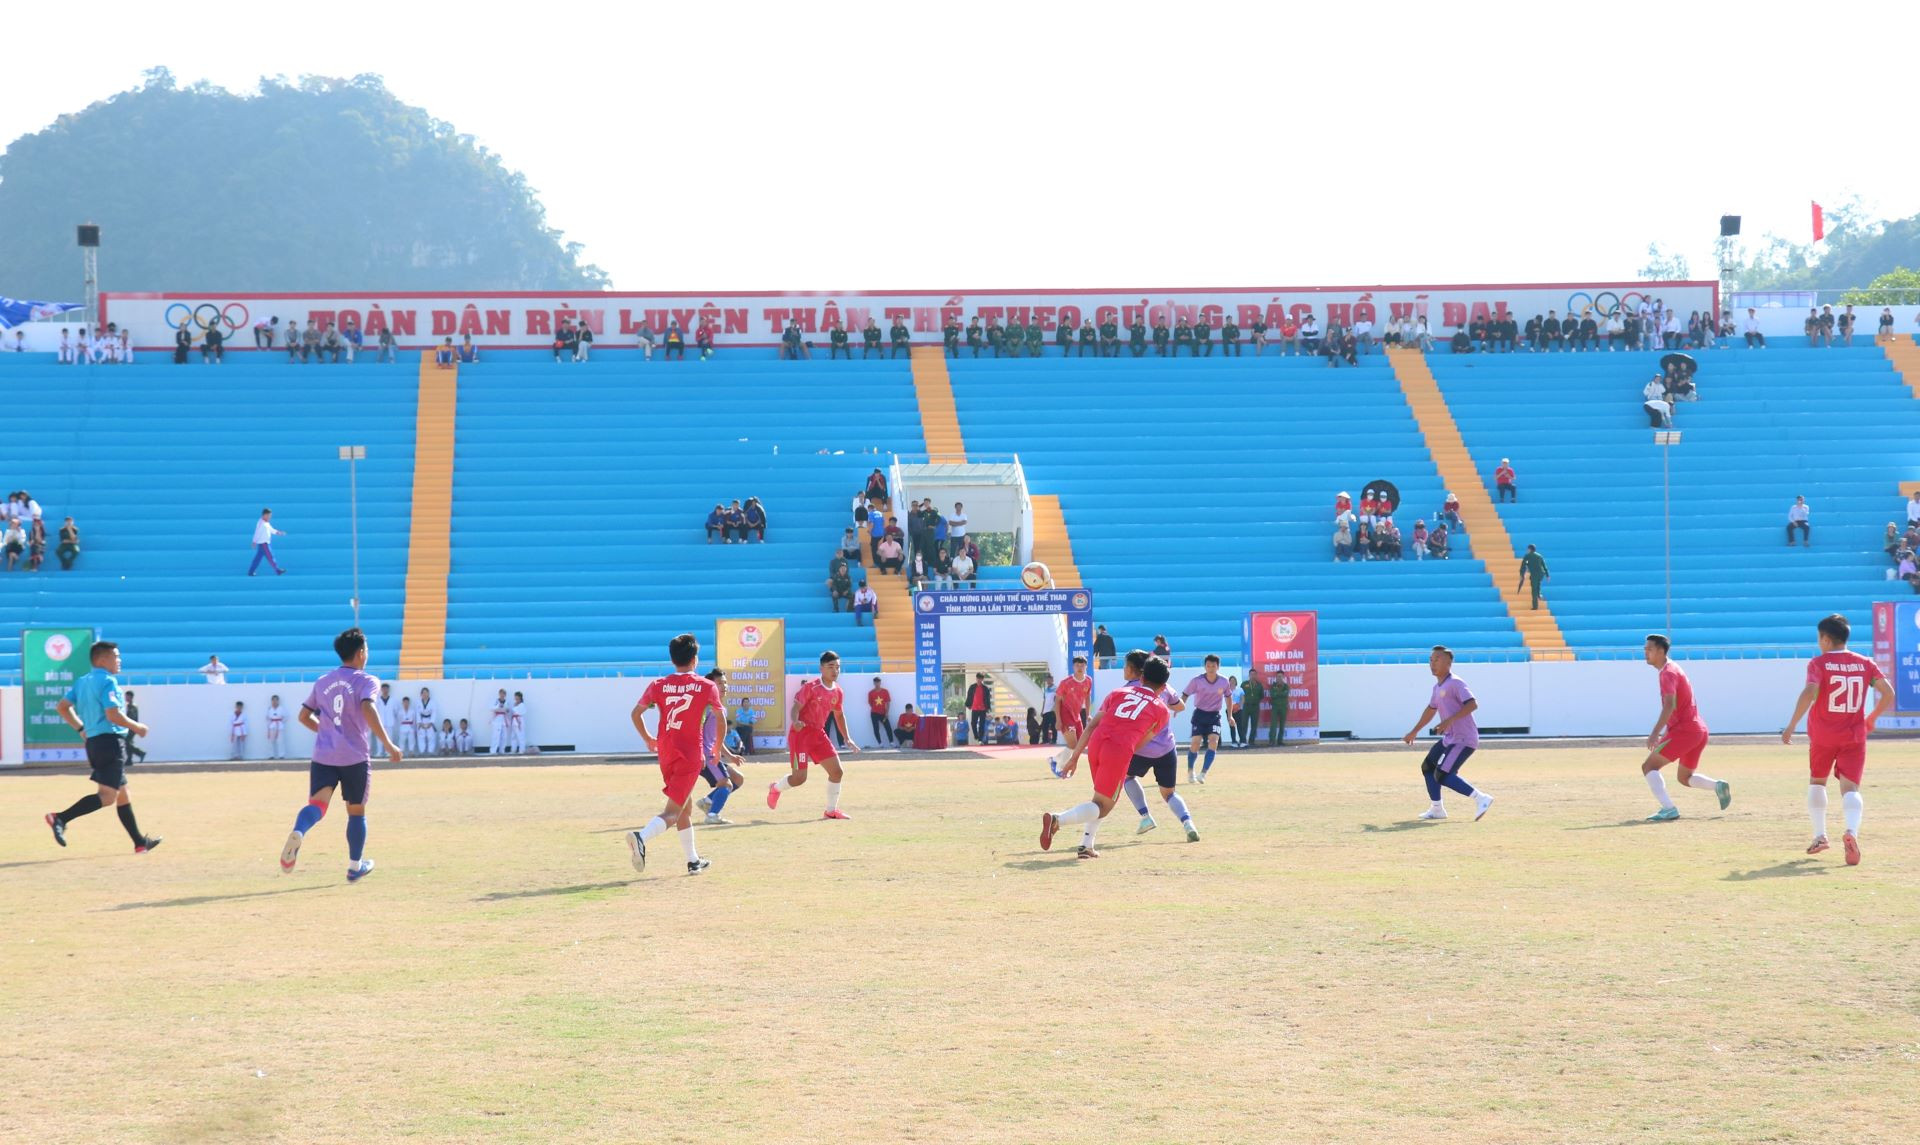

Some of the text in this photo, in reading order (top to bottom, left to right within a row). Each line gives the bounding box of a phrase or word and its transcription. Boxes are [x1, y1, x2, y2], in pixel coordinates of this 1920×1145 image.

[308, 303, 416, 335] TOÀN
[432, 303, 511, 335] DÂN
[526, 303, 604, 335] RÈN
[763, 300, 871, 333] THÂN
[885, 295, 965, 333] THỂ
[978, 305, 1082, 333] THEO
[1095, 298, 1224, 331] GƯƠNG
[1237, 297, 1313, 330] BÁC
[1327, 292, 1376, 329] HỒ
[940, 594, 958, 602] CHÀO
[981, 595, 993, 603] ĐẠI
[994, 594, 1006, 603] HỘI
[1007, 592, 1020, 601] THỂ
[1021, 594, 1035, 602] DỤC
[1036, 592, 1049, 601] THỂ
[946, 604, 962, 612] TỈNH
[988, 603, 1001, 612] LẦN
[1003, 604, 1016, 612] THỨ
[1028, 603, 1044, 611] NĂM
[1265, 649, 1304, 660] TOÀN DÂN
[732, 657, 769, 667] THỂ THAO
[1264, 662, 1280, 672] RÈN
[1825, 661, 1840, 671] CÔNG
[1858, 663, 1866, 672] LA
[1289, 673, 1304, 685] THỂ
[662, 683, 677, 693] CÔNG
[677, 685, 686, 694] AN
[695, 684, 702, 693] LA
[727, 684, 753, 693] TRUNG
[1828, 675, 1864, 713] 20
[726, 697, 742, 705] CAO
[333, 694, 344, 726] 9
[1114, 693, 1149, 721] 21
